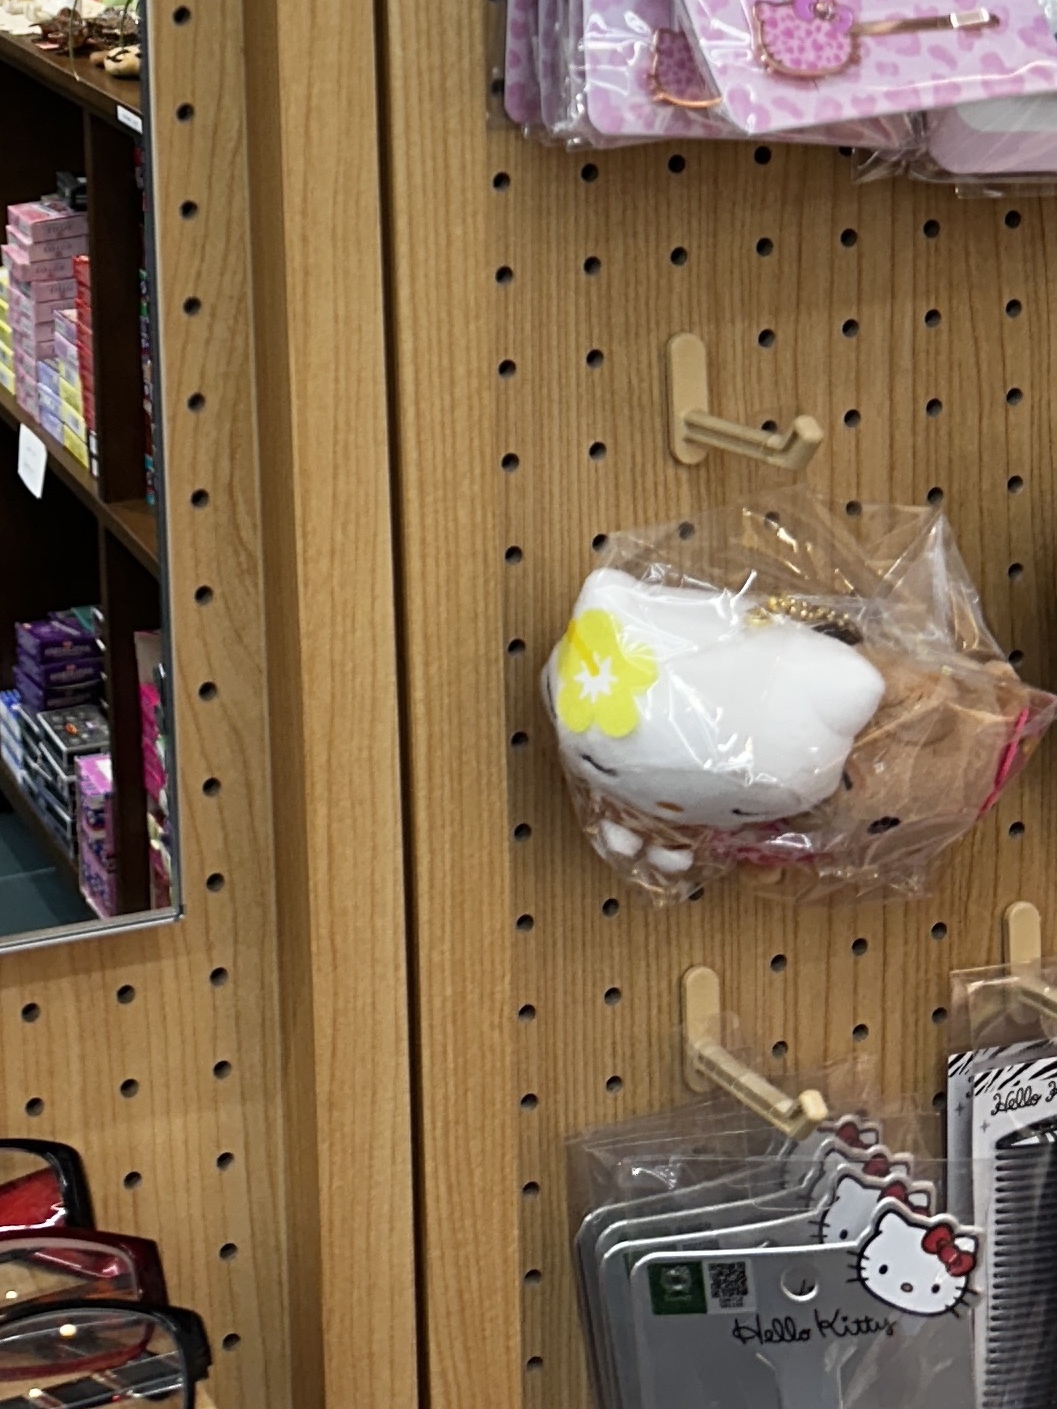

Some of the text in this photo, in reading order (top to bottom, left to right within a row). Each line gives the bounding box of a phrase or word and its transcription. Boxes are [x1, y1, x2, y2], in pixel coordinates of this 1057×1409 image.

[990, 1085, 1042, 1116] Hello
[732, 1308, 895, 1345] Hello Kitty
